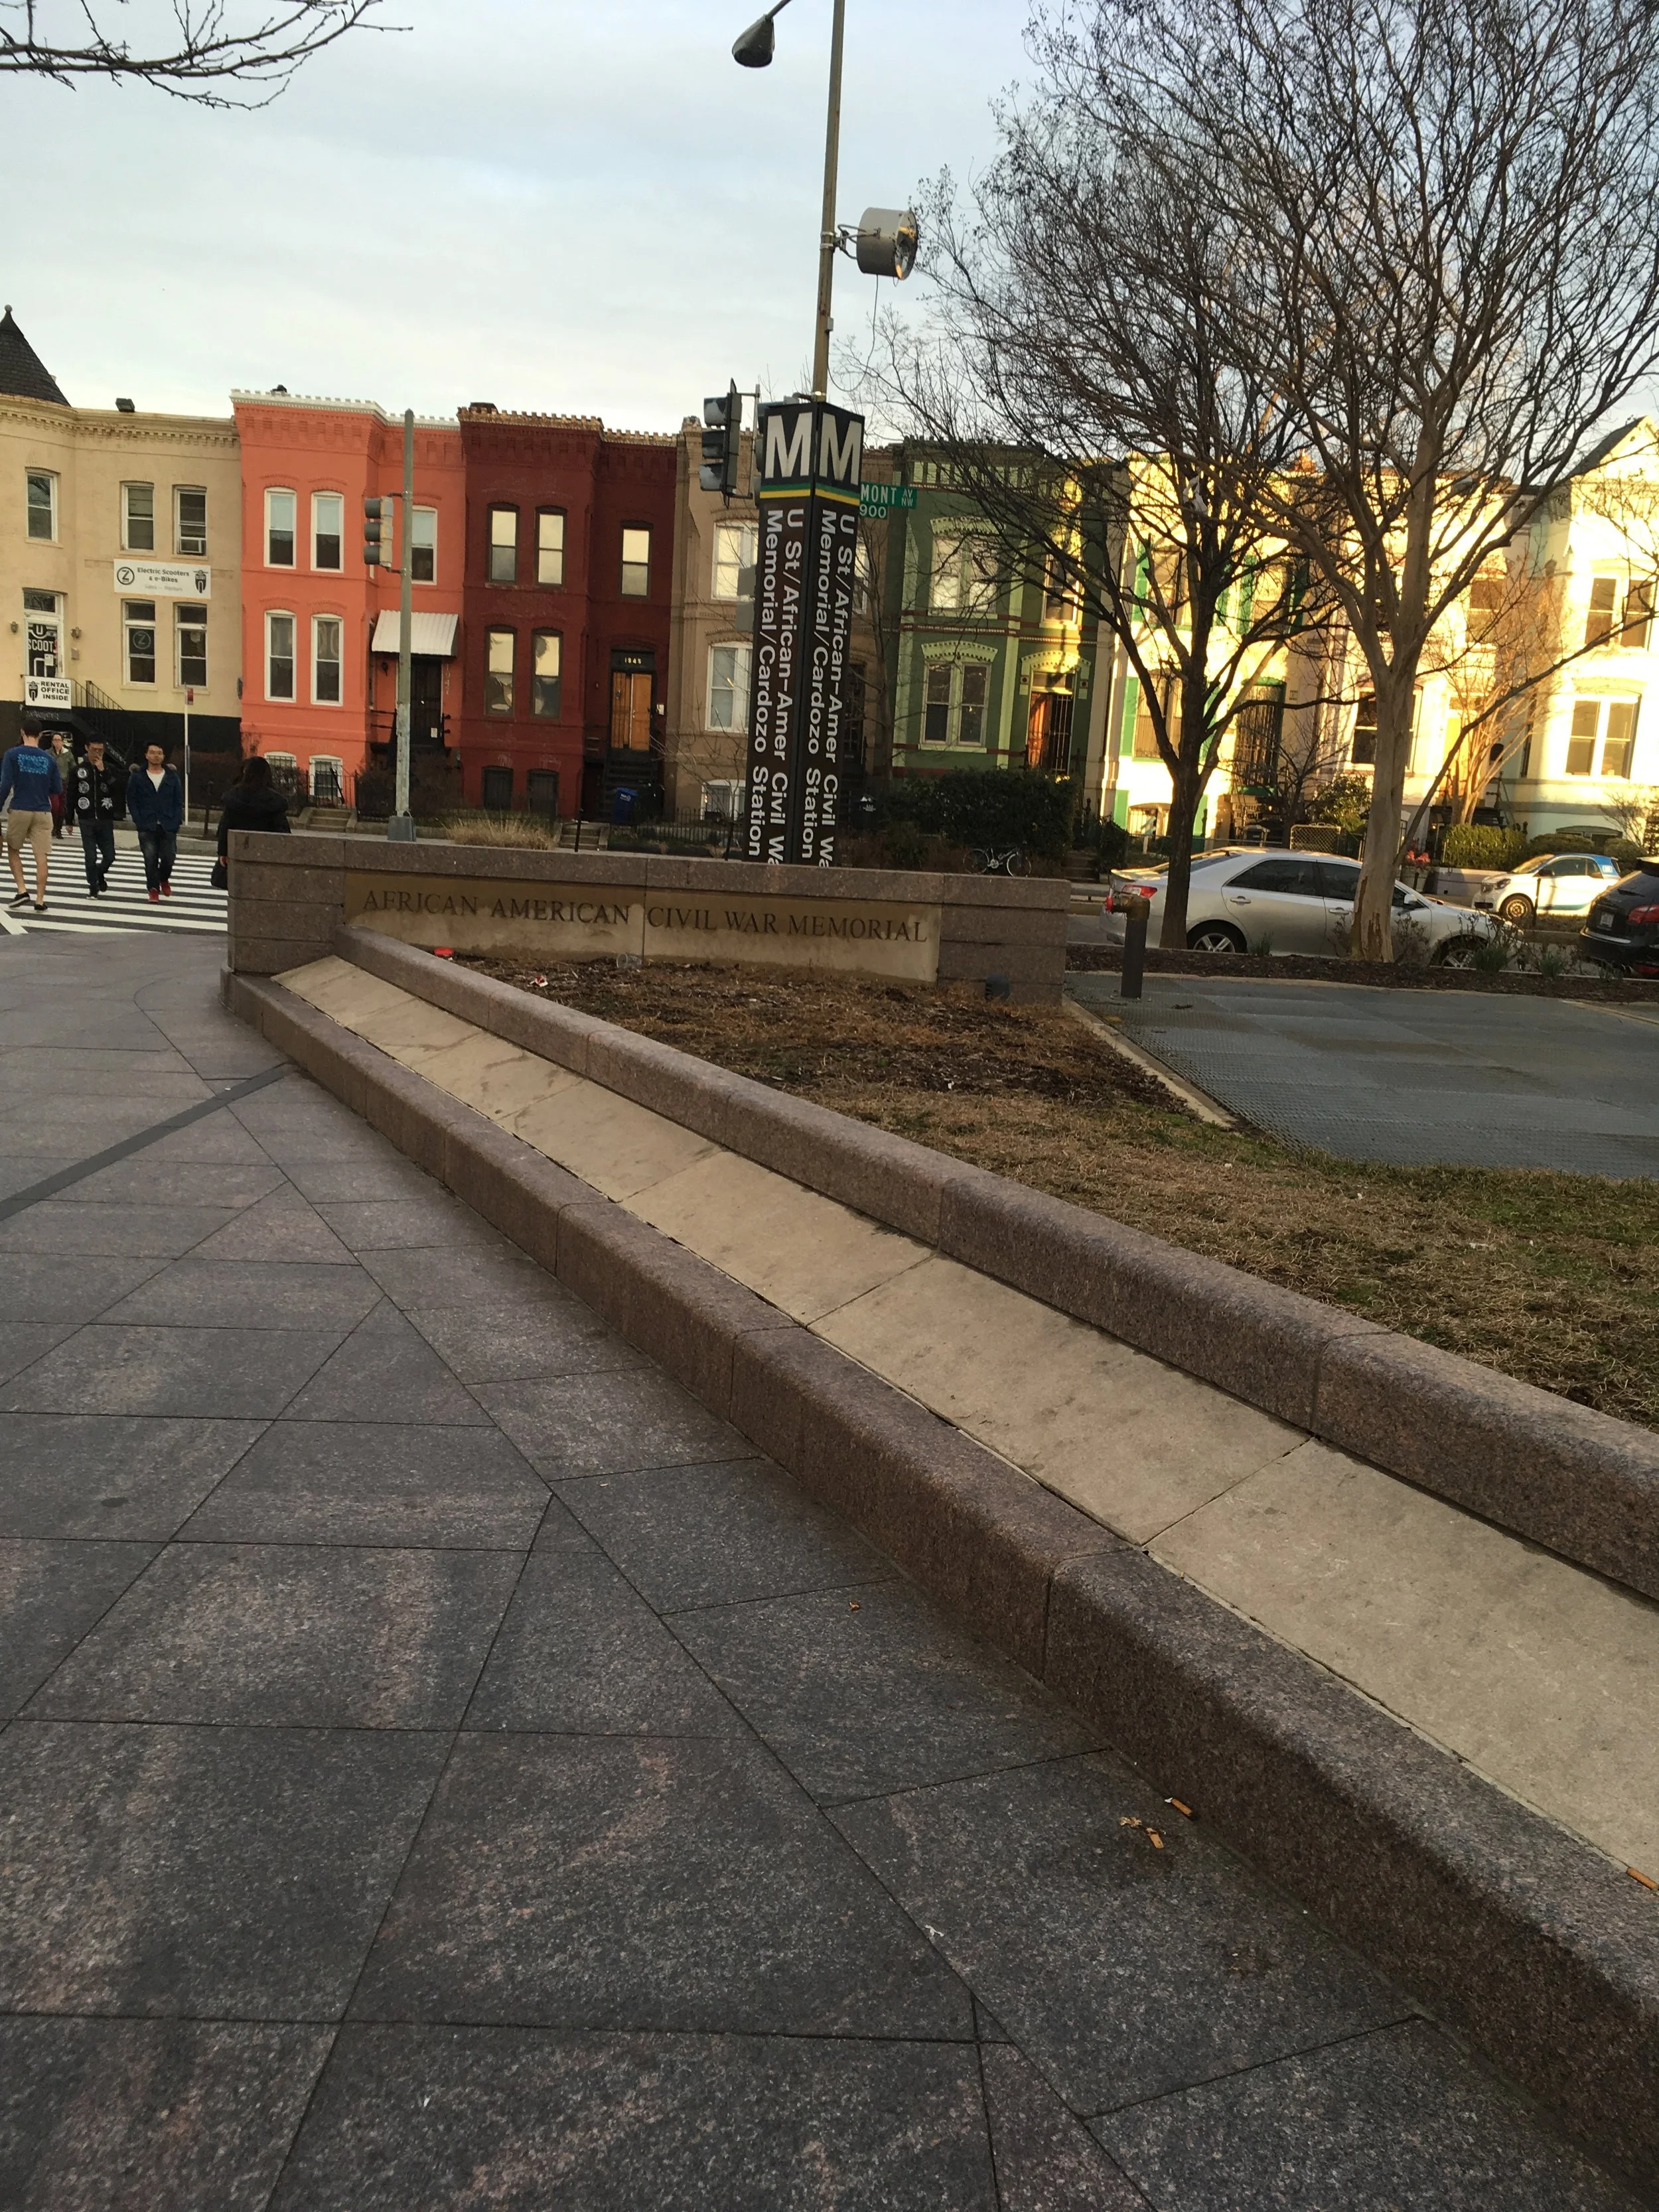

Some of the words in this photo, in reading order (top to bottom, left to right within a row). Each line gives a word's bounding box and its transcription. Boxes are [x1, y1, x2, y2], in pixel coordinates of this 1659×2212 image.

[764, 411, 813, 479] M
[818, 412, 862, 485] M
[787, 509, 804, 528] U
[859, 504, 887, 518] 900
[860, 483, 897, 504] MONT
[901, 497, 913, 506] NW
[903, 488, 912, 498] AV
[839, 514, 855, 534] U
[754, 510, 783, 753] Memorial/Cardozo
[808, 509, 837, 755] Memorial/Cardozo
[749, 767, 768, 855] Station
[770, 773, 788, 824] Civil
[802, 768, 821, 858] Station
[822, 774, 838, 826] Civil
[363, 890, 479, 917] AFRICAN
[490, 898, 629, 924] AMERICAN
[647, 907, 717, 930] CIVIL
[724, 911, 780, 935] WAR
[786, 914, 928, 942] MEMORIAL
